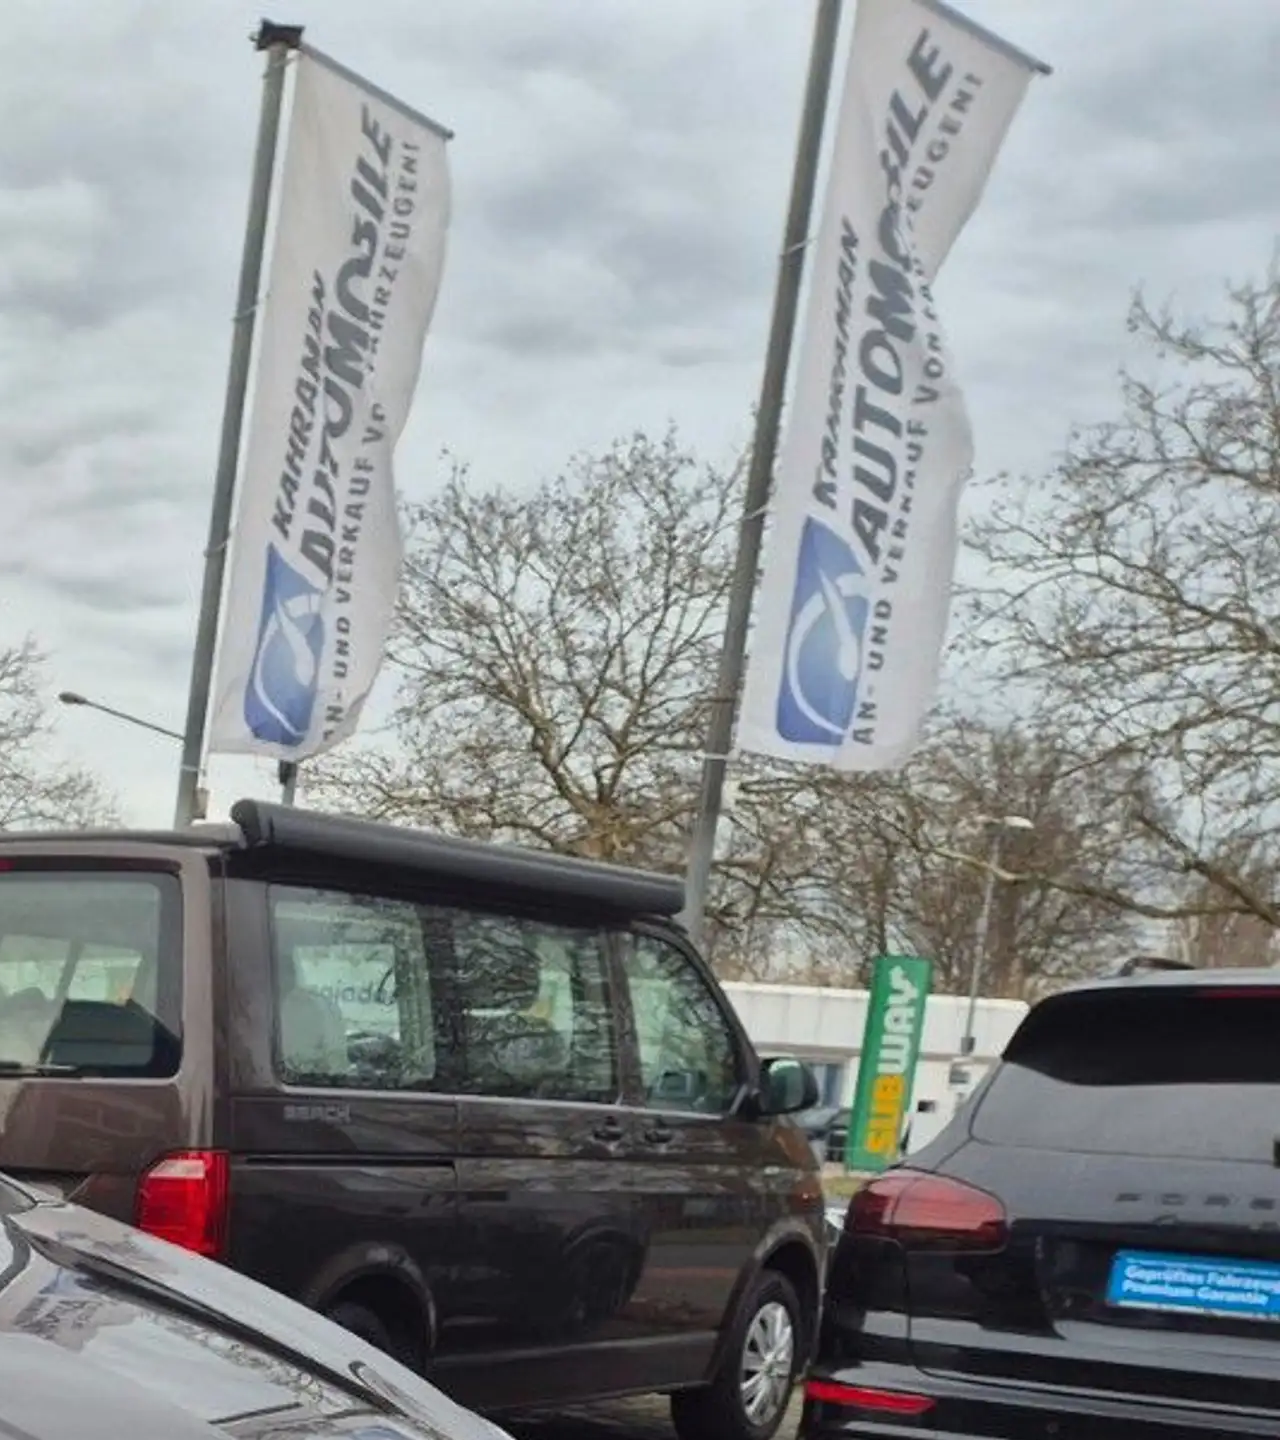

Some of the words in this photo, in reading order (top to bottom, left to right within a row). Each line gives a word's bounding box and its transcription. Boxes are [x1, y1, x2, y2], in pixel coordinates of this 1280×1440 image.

[336, 457, 376, 605] VERKAUF
[867, 600, 892, 672] UND
[911, 332, 944, 405] VON
[334, 616, 351, 679] UND
[865, 965, 920, 1160] SUBWAY
